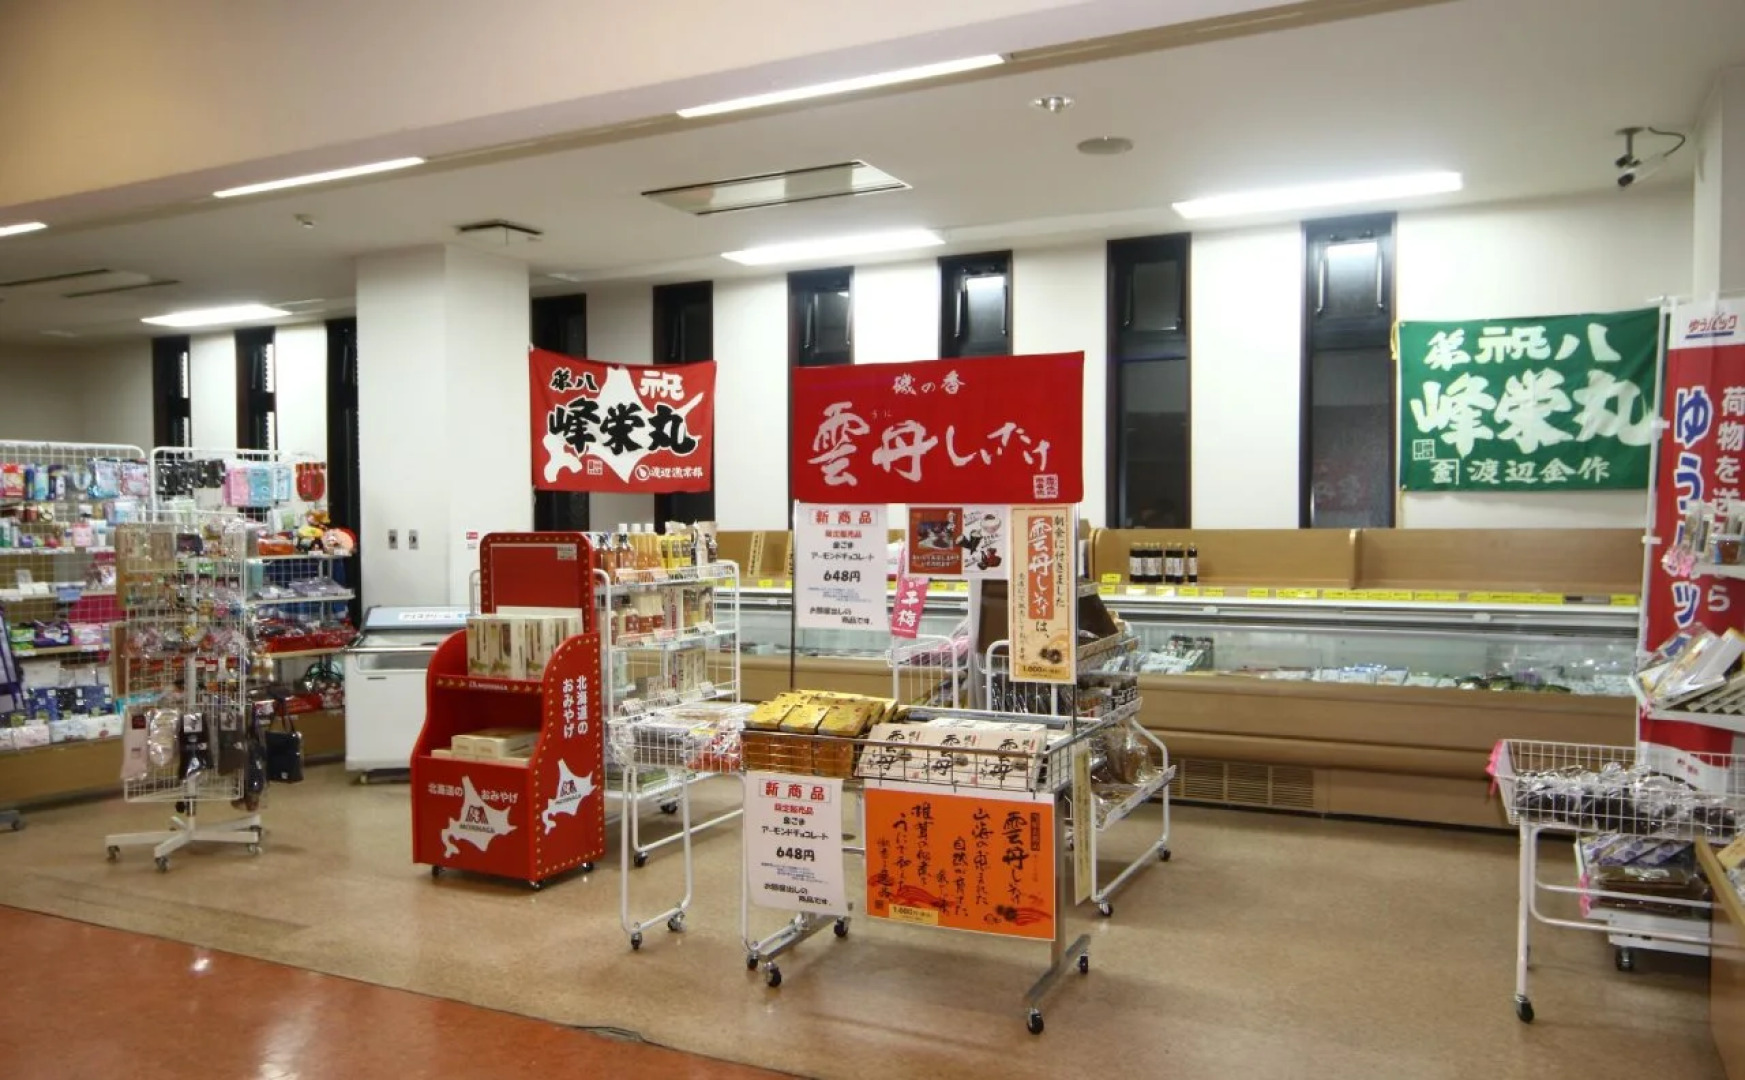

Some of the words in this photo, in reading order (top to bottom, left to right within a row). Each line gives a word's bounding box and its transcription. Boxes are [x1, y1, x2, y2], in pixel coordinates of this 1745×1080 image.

[640, 370, 684, 399] 祝
[892, 370, 966, 395] 磯の香
[1410, 368, 1662, 458] 峰栄丸
[547, 396, 697, 456] 峰栄丸
[807, 401, 1050, 486] 雲丹しいたけ
[816, 510, 872, 525] 新商品
[823, 570, 861, 583] 648円
[563, 678, 575, 739] おみやげ
[577, 675, 588, 735] 北海道の
[481, 790, 518, 804] おみやげ
[765, 781, 824, 801] 新商品
[762, 825, 829, 840] アーモンドチョコレート
[776, 846, 815, 861] 648円
